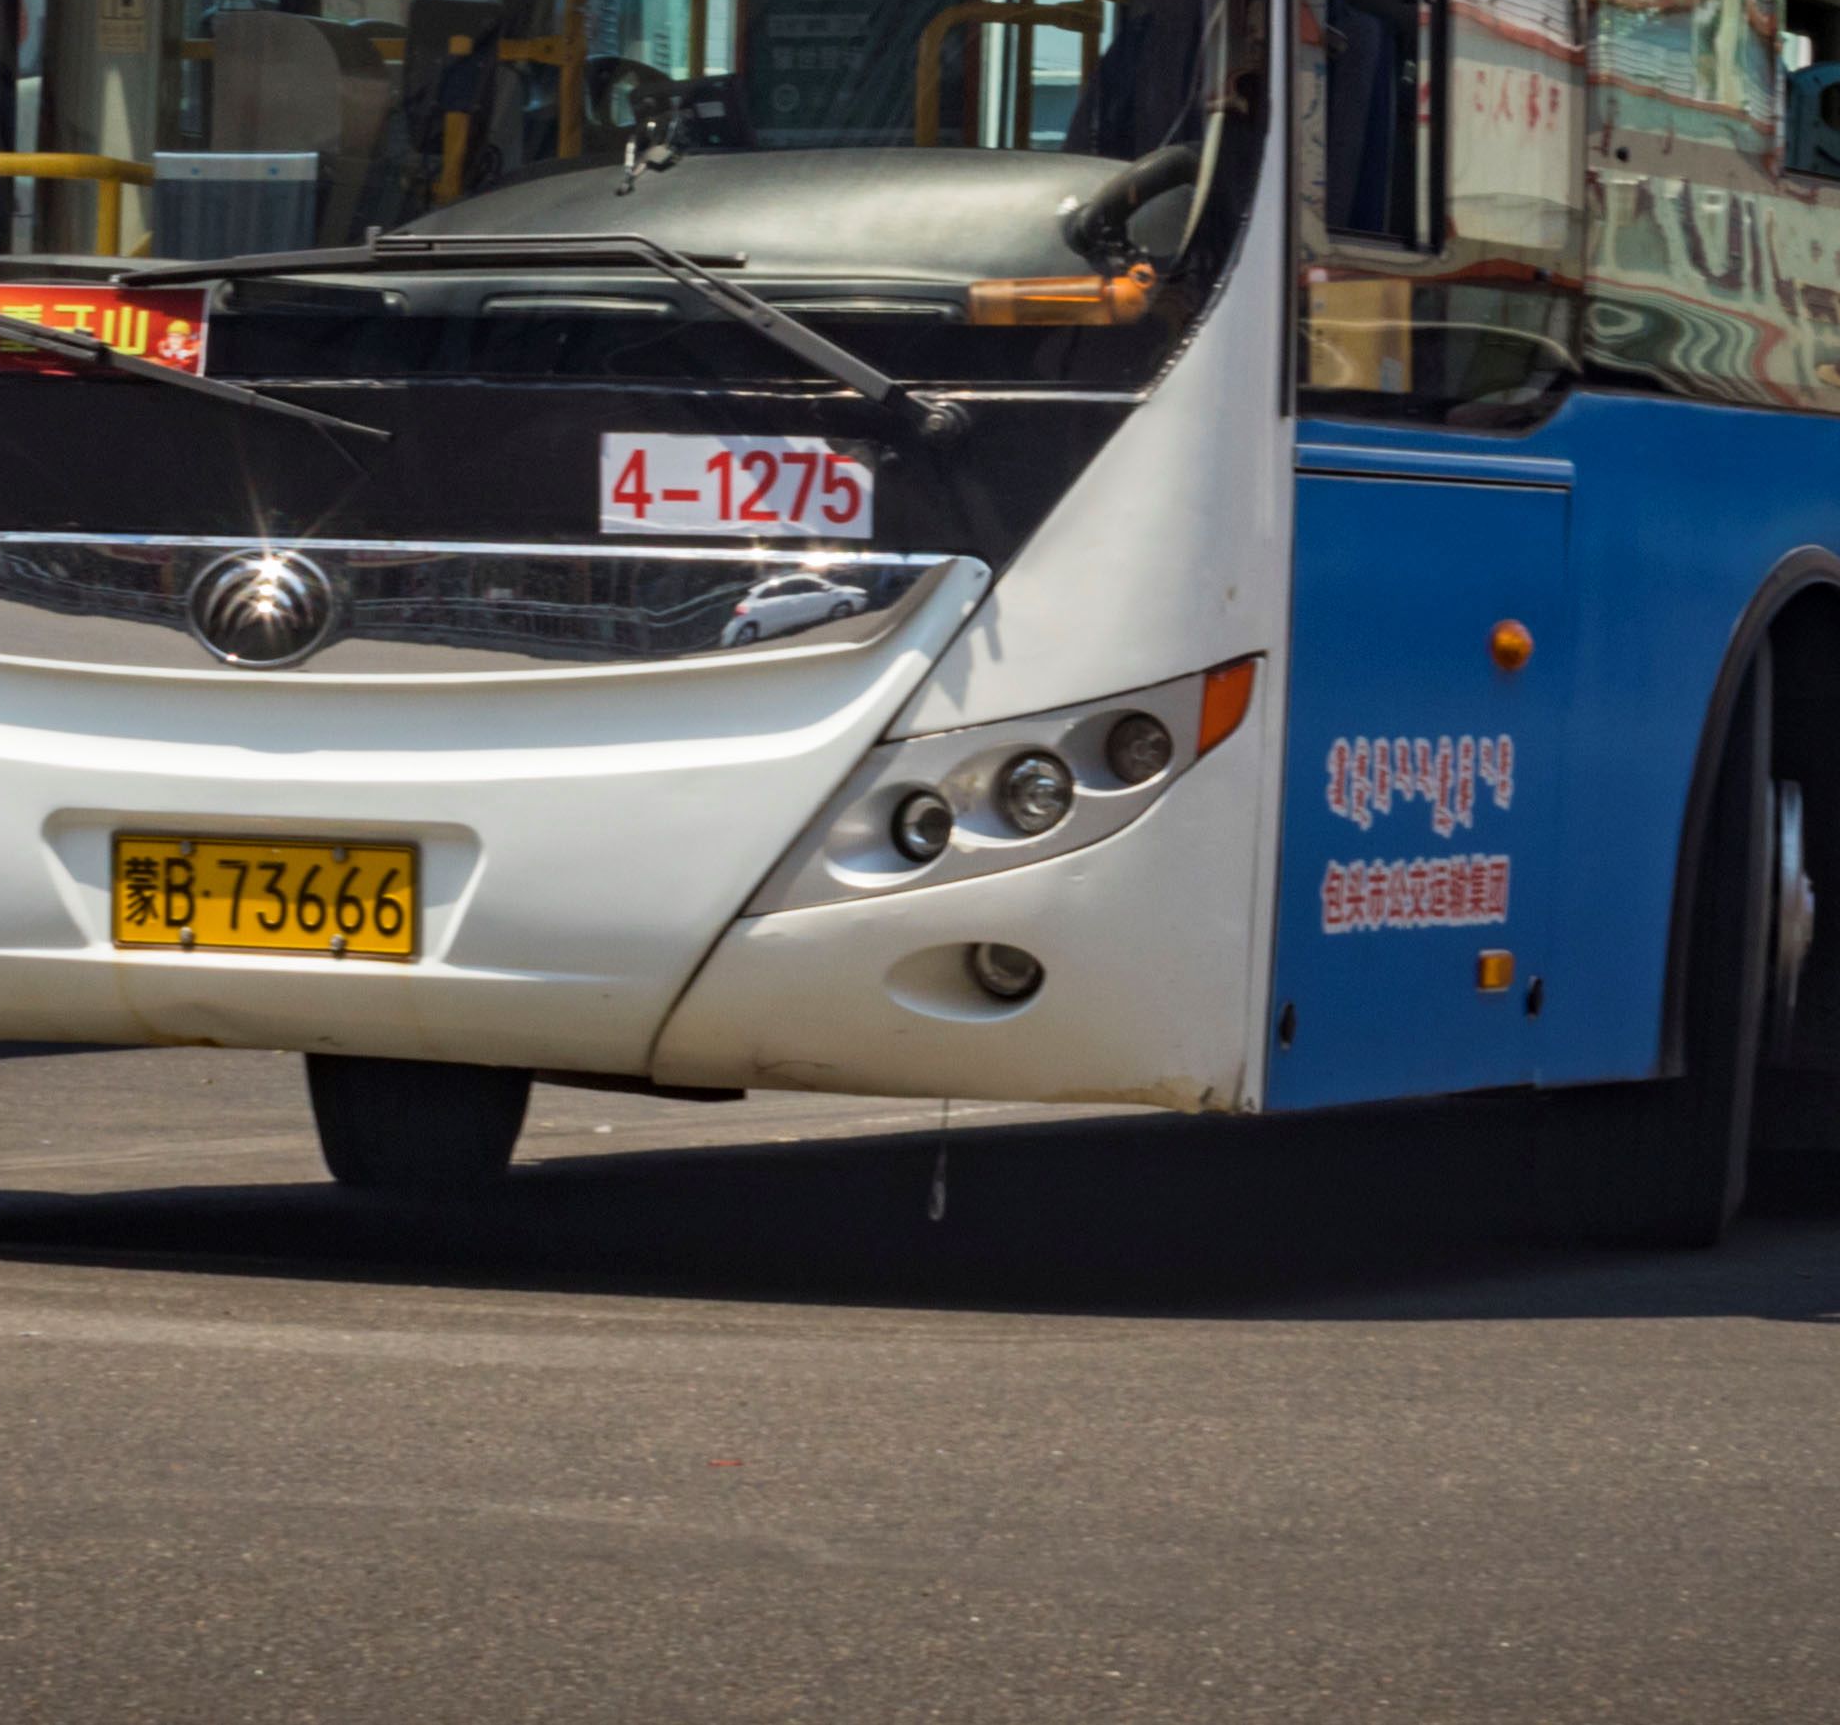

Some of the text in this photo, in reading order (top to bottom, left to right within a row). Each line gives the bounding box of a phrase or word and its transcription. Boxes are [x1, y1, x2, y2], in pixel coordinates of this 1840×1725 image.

[612, 448, 862, 525] 4-1275
[1321, 853, 1510, 935] 包头市公交运输集团
